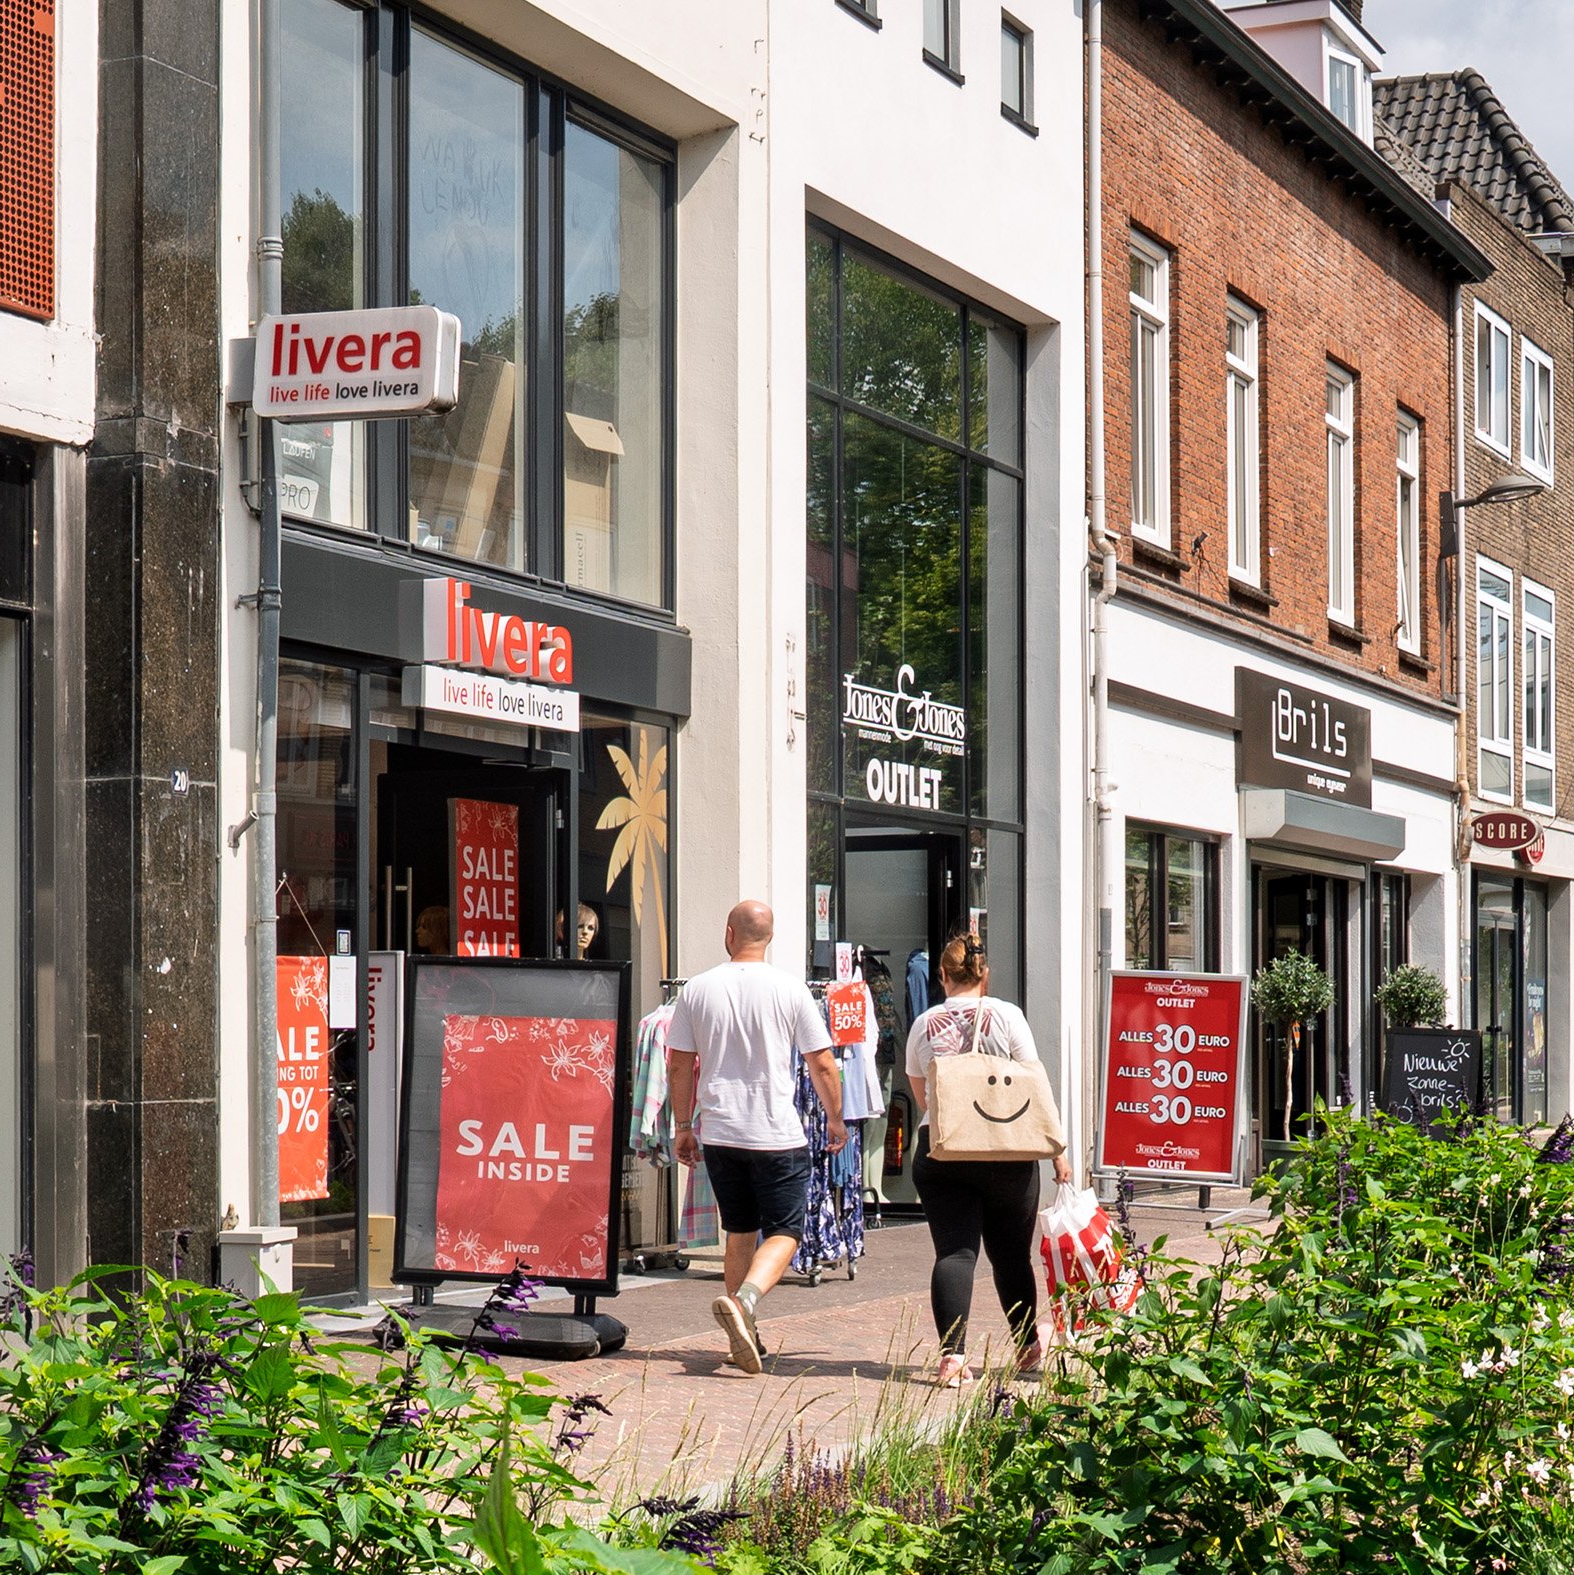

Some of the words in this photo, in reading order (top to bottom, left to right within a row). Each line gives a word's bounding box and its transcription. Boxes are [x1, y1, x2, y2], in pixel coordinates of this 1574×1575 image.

[272, 324, 421, 376] livera
[270, 386, 298, 403] live
[304, 383, 330, 400] life
[335, 382, 368, 399] love
[372, 380, 419, 397] livera
[445, 577, 573, 685] livera
[443, 678, 468, 705] live
[472, 682, 494, 709] life
[498, 687, 525, 715] love
[528, 693, 563, 721] livera
[1277, 688, 1347, 757] Brils
[174, 769, 187, 791] 20
[866, 758, 942, 810] OUTLET
[1475, 822, 1528, 840] SCORE
[462, 845, 515, 882] SALE
[463, 885, 516, 920] SALE
[834, 1001, 863, 1013] SALE
[1156, 998, 1195, 1008] OUTLET
[834, 1014, 863, 1031] 50%
[276, 1026, 320, 1062] ALE
[1119, 1031, 1153, 1043] ALLES
[1153, 1023, 1196, 1054] 30
[1198, 1035, 1231, 1047] EURO
[300, 1066, 320, 1081] TOT
[1117, 1066, 1151, 1078] ALLES
[1151, 1058, 1194, 1090] 30
[1196, 1070, 1229, 1083] EURO
[1403, 1053, 1459, 1072] Nieuwe
[277, 1087, 320, 1135] 0%
[1115, 1102, 1149, 1114] ALLES
[1149, 1094, 1192, 1125] 30
[1194, 1106, 1227, 1119] EURO
[456, 1119, 595, 1161] SALE
[477, 1161, 570, 1182] INSIDE
[1147, 1159, 1186, 1170] OUTLET
[504, 1240, 540, 1254] livera
